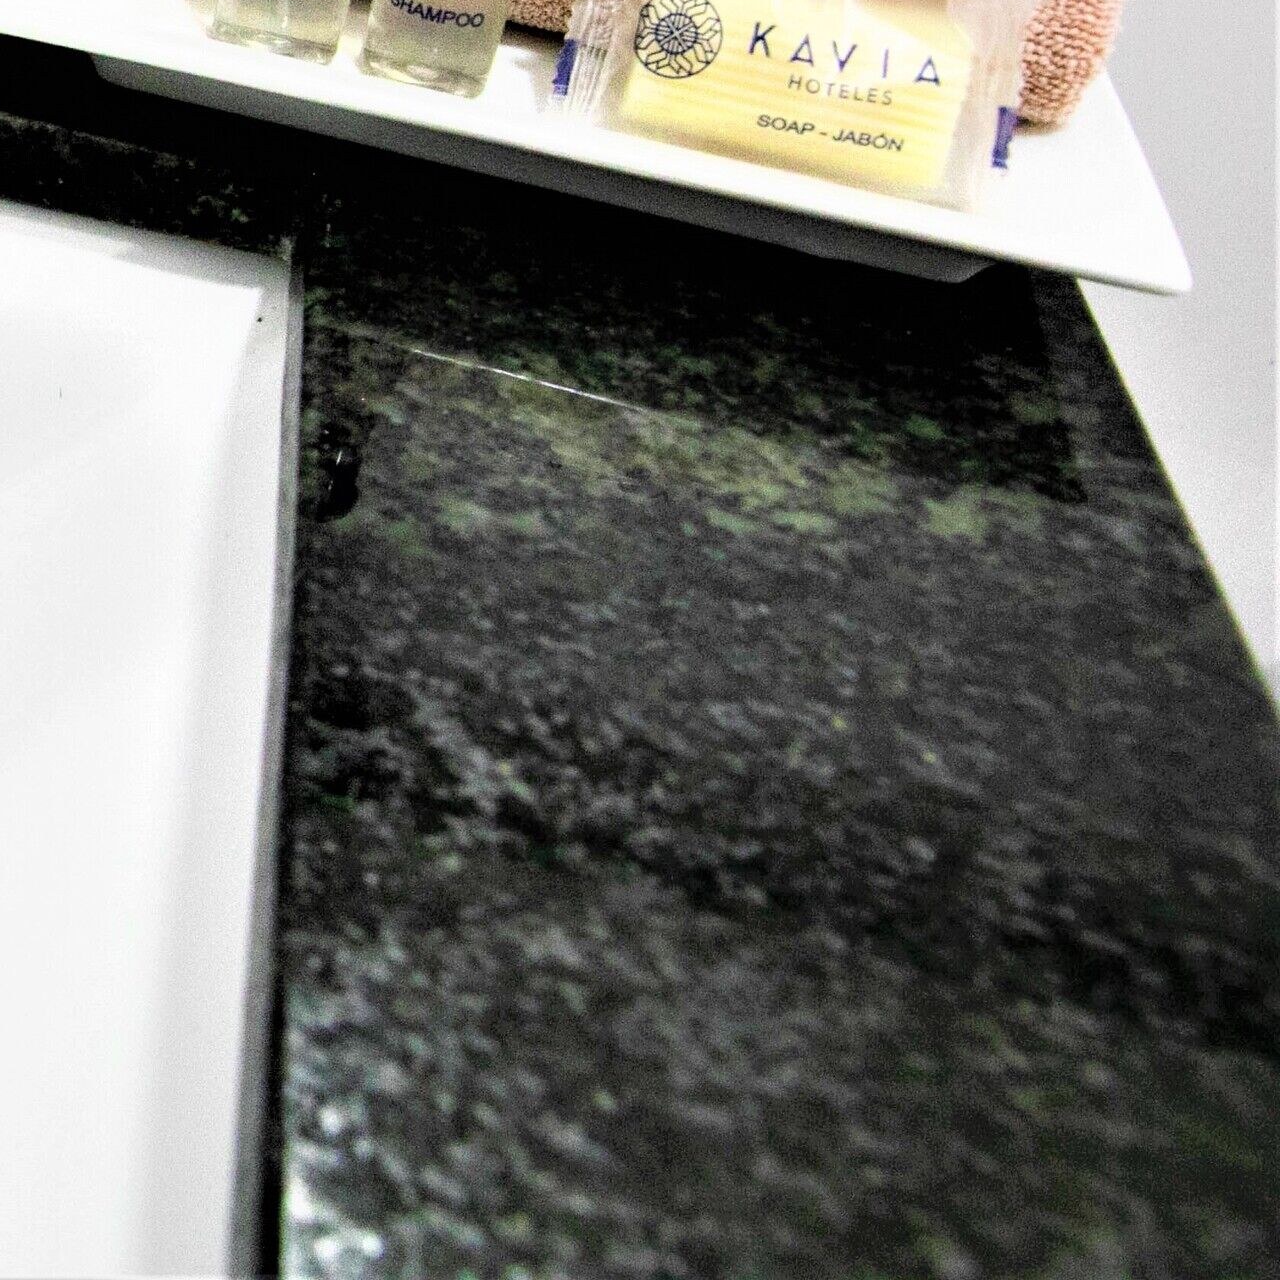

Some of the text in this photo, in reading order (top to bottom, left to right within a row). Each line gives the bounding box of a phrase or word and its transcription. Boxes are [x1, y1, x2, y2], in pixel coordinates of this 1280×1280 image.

[748, 21, 940, 86] KAVIA
[788, 74, 893, 106] HOTELES
[756, 114, 815, 135] SOAP
[832, 130, 904, 152] JABÓN
